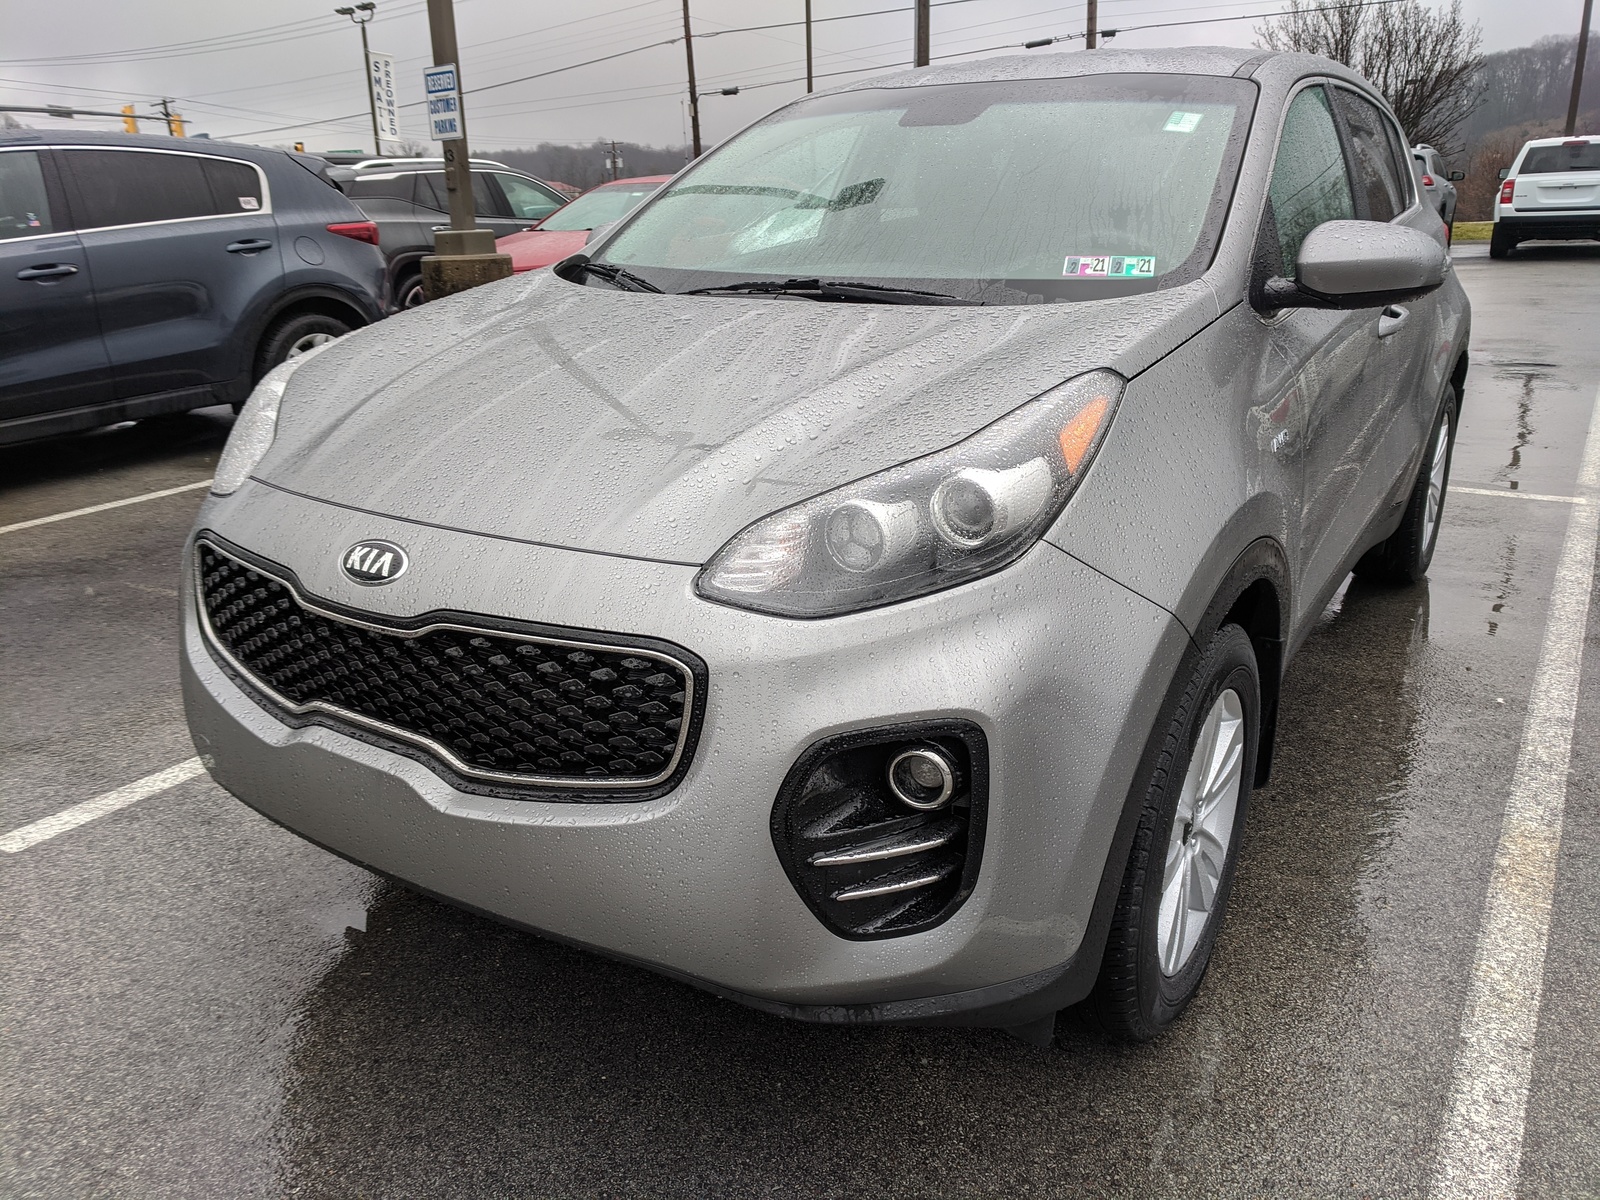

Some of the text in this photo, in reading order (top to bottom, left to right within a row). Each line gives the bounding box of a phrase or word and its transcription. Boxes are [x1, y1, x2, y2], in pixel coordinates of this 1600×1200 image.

[426, 73, 455, 92] RESERVED
[384, 60, 397, 136] PREOWNED
[429, 97, 457, 115] CUSTOMER
[434, 118, 457, 134] PARKING
[1069, 262, 1078, 274] 2
[1093, 258, 1105, 272] 21
[1114, 261, 1122, 274] 2
[1139, 258, 1151, 273] 21
[346, 546, 394, 577] KIA
